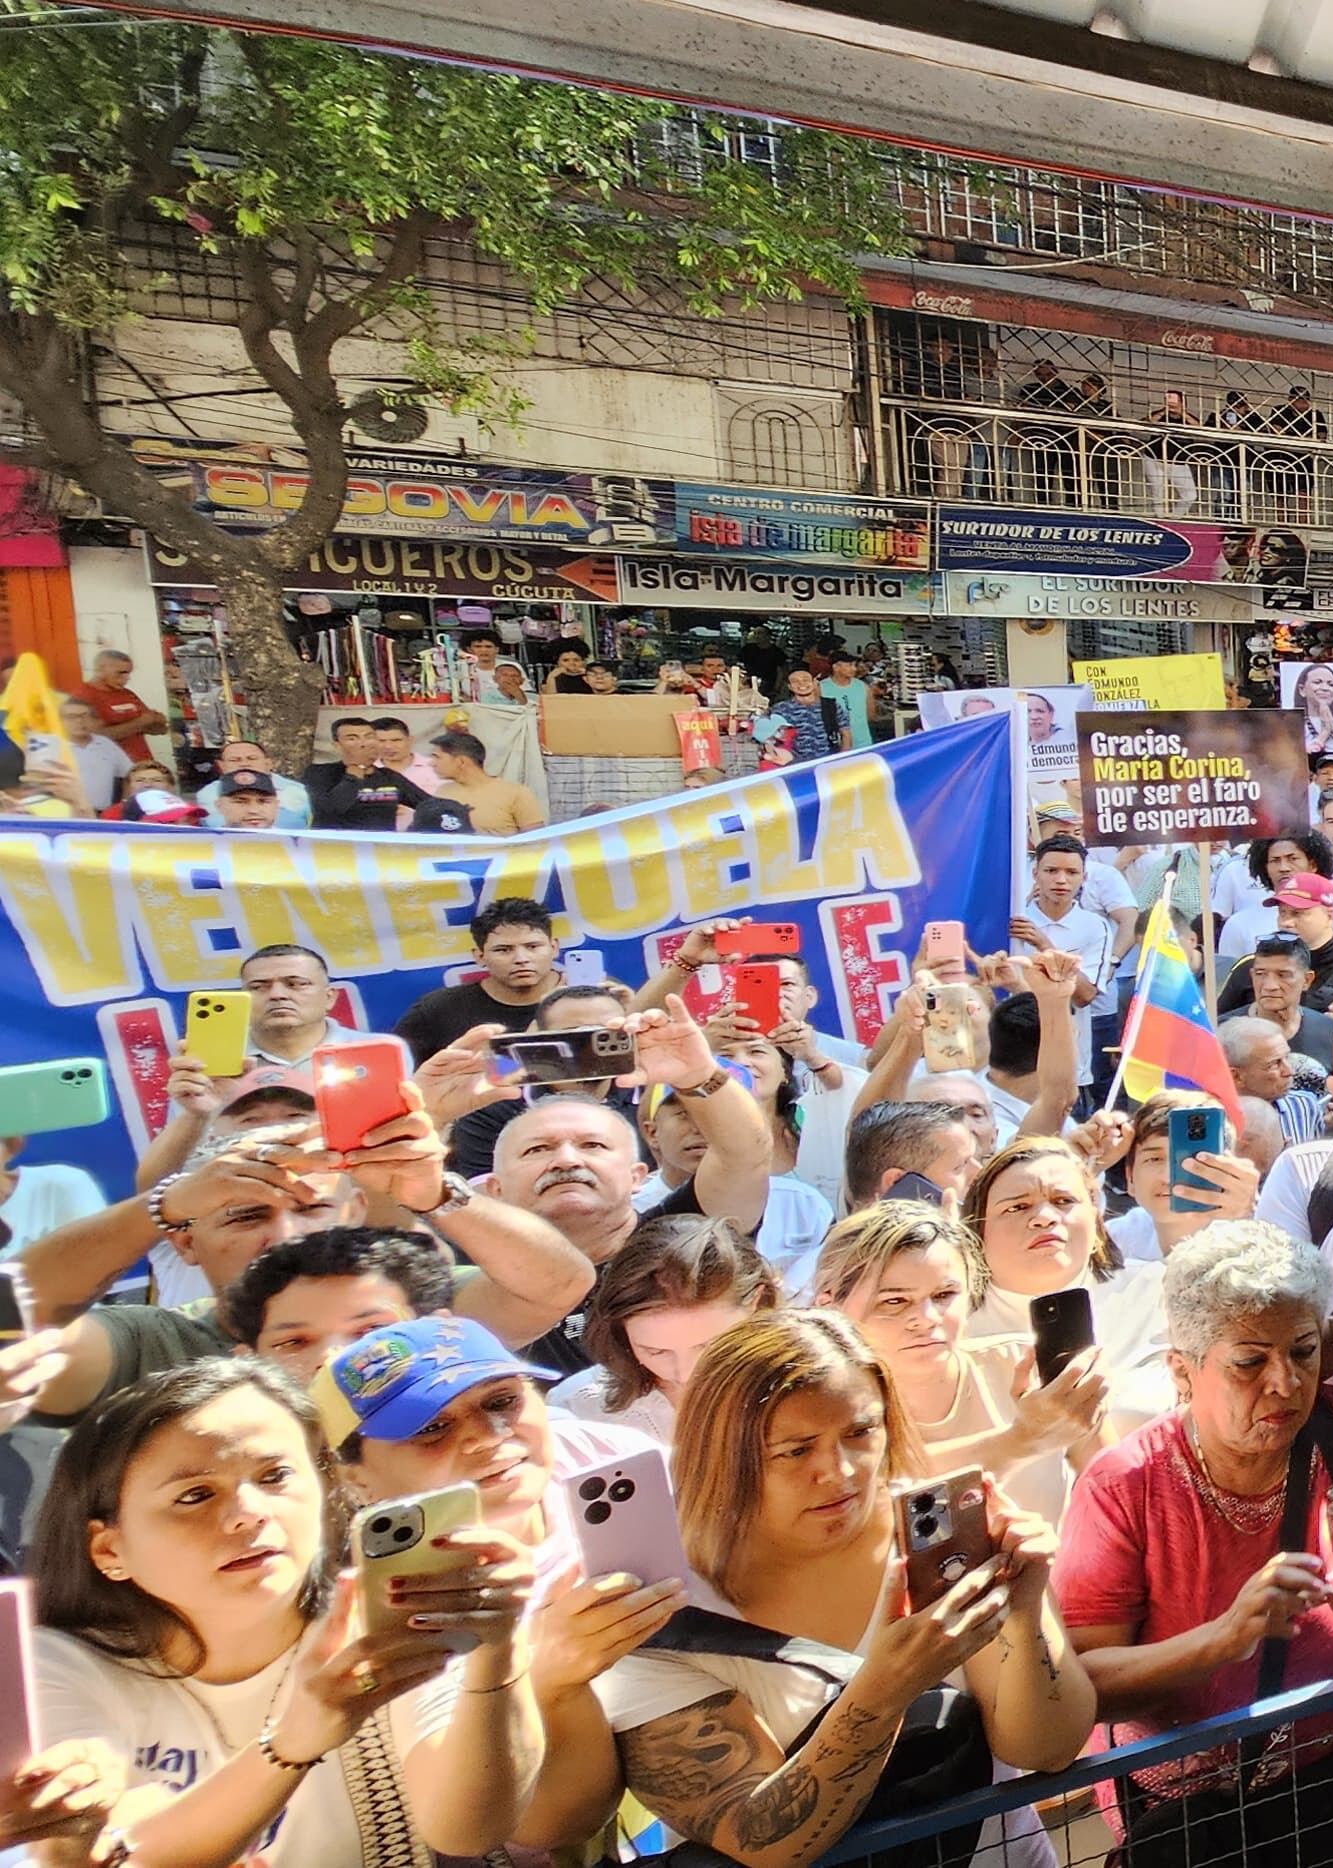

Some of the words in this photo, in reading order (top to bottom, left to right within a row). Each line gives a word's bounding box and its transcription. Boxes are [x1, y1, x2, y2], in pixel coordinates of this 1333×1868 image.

[346, 457, 478, 478] VARIEDADES
[708, 495, 785, 512] CENTRO
[791, 501, 897, 522] COMERCIAL
[942, 520, 1035, 538] SURTIDOR
[1040, 527, 1064, 540] DE
[1068, 527, 1100, 542] LOS
[1104, 529, 1164, 545] LENTES
[353, 579, 400, 593] LOCAL
[429, 582, 438, 594] 2
[492, 582, 576, 600] CÚCUTA
[1040, 576, 1068, 592] EL
[1073, 577, 1185, 595] SURTIDOR
[1028, 596, 1060, 614] DE
[1068, 597, 1114, 616] LOS
[1120, 598, 1200, 618] LENTES
[1086, 666, 1106, 678] CON
[1031, 743, 1076, 755] Edmund
[1090, 732, 1188, 757] Gracias,
[1031, 756, 1075, 768] democr
[1093, 754, 1162, 783] María
[1169, 753, 1251, 782] Corina,
[1095, 785, 1138, 812] por
[1143, 783, 1183, 805] ser
[1187, 779, 1209, 802] el
[1215, 777, 1261, 801] faro
[1097, 806, 1127, 834] de
[1133, 803, 1258, 836] esperanza.
[0, 754, 922, 1005] VENEZUELA
